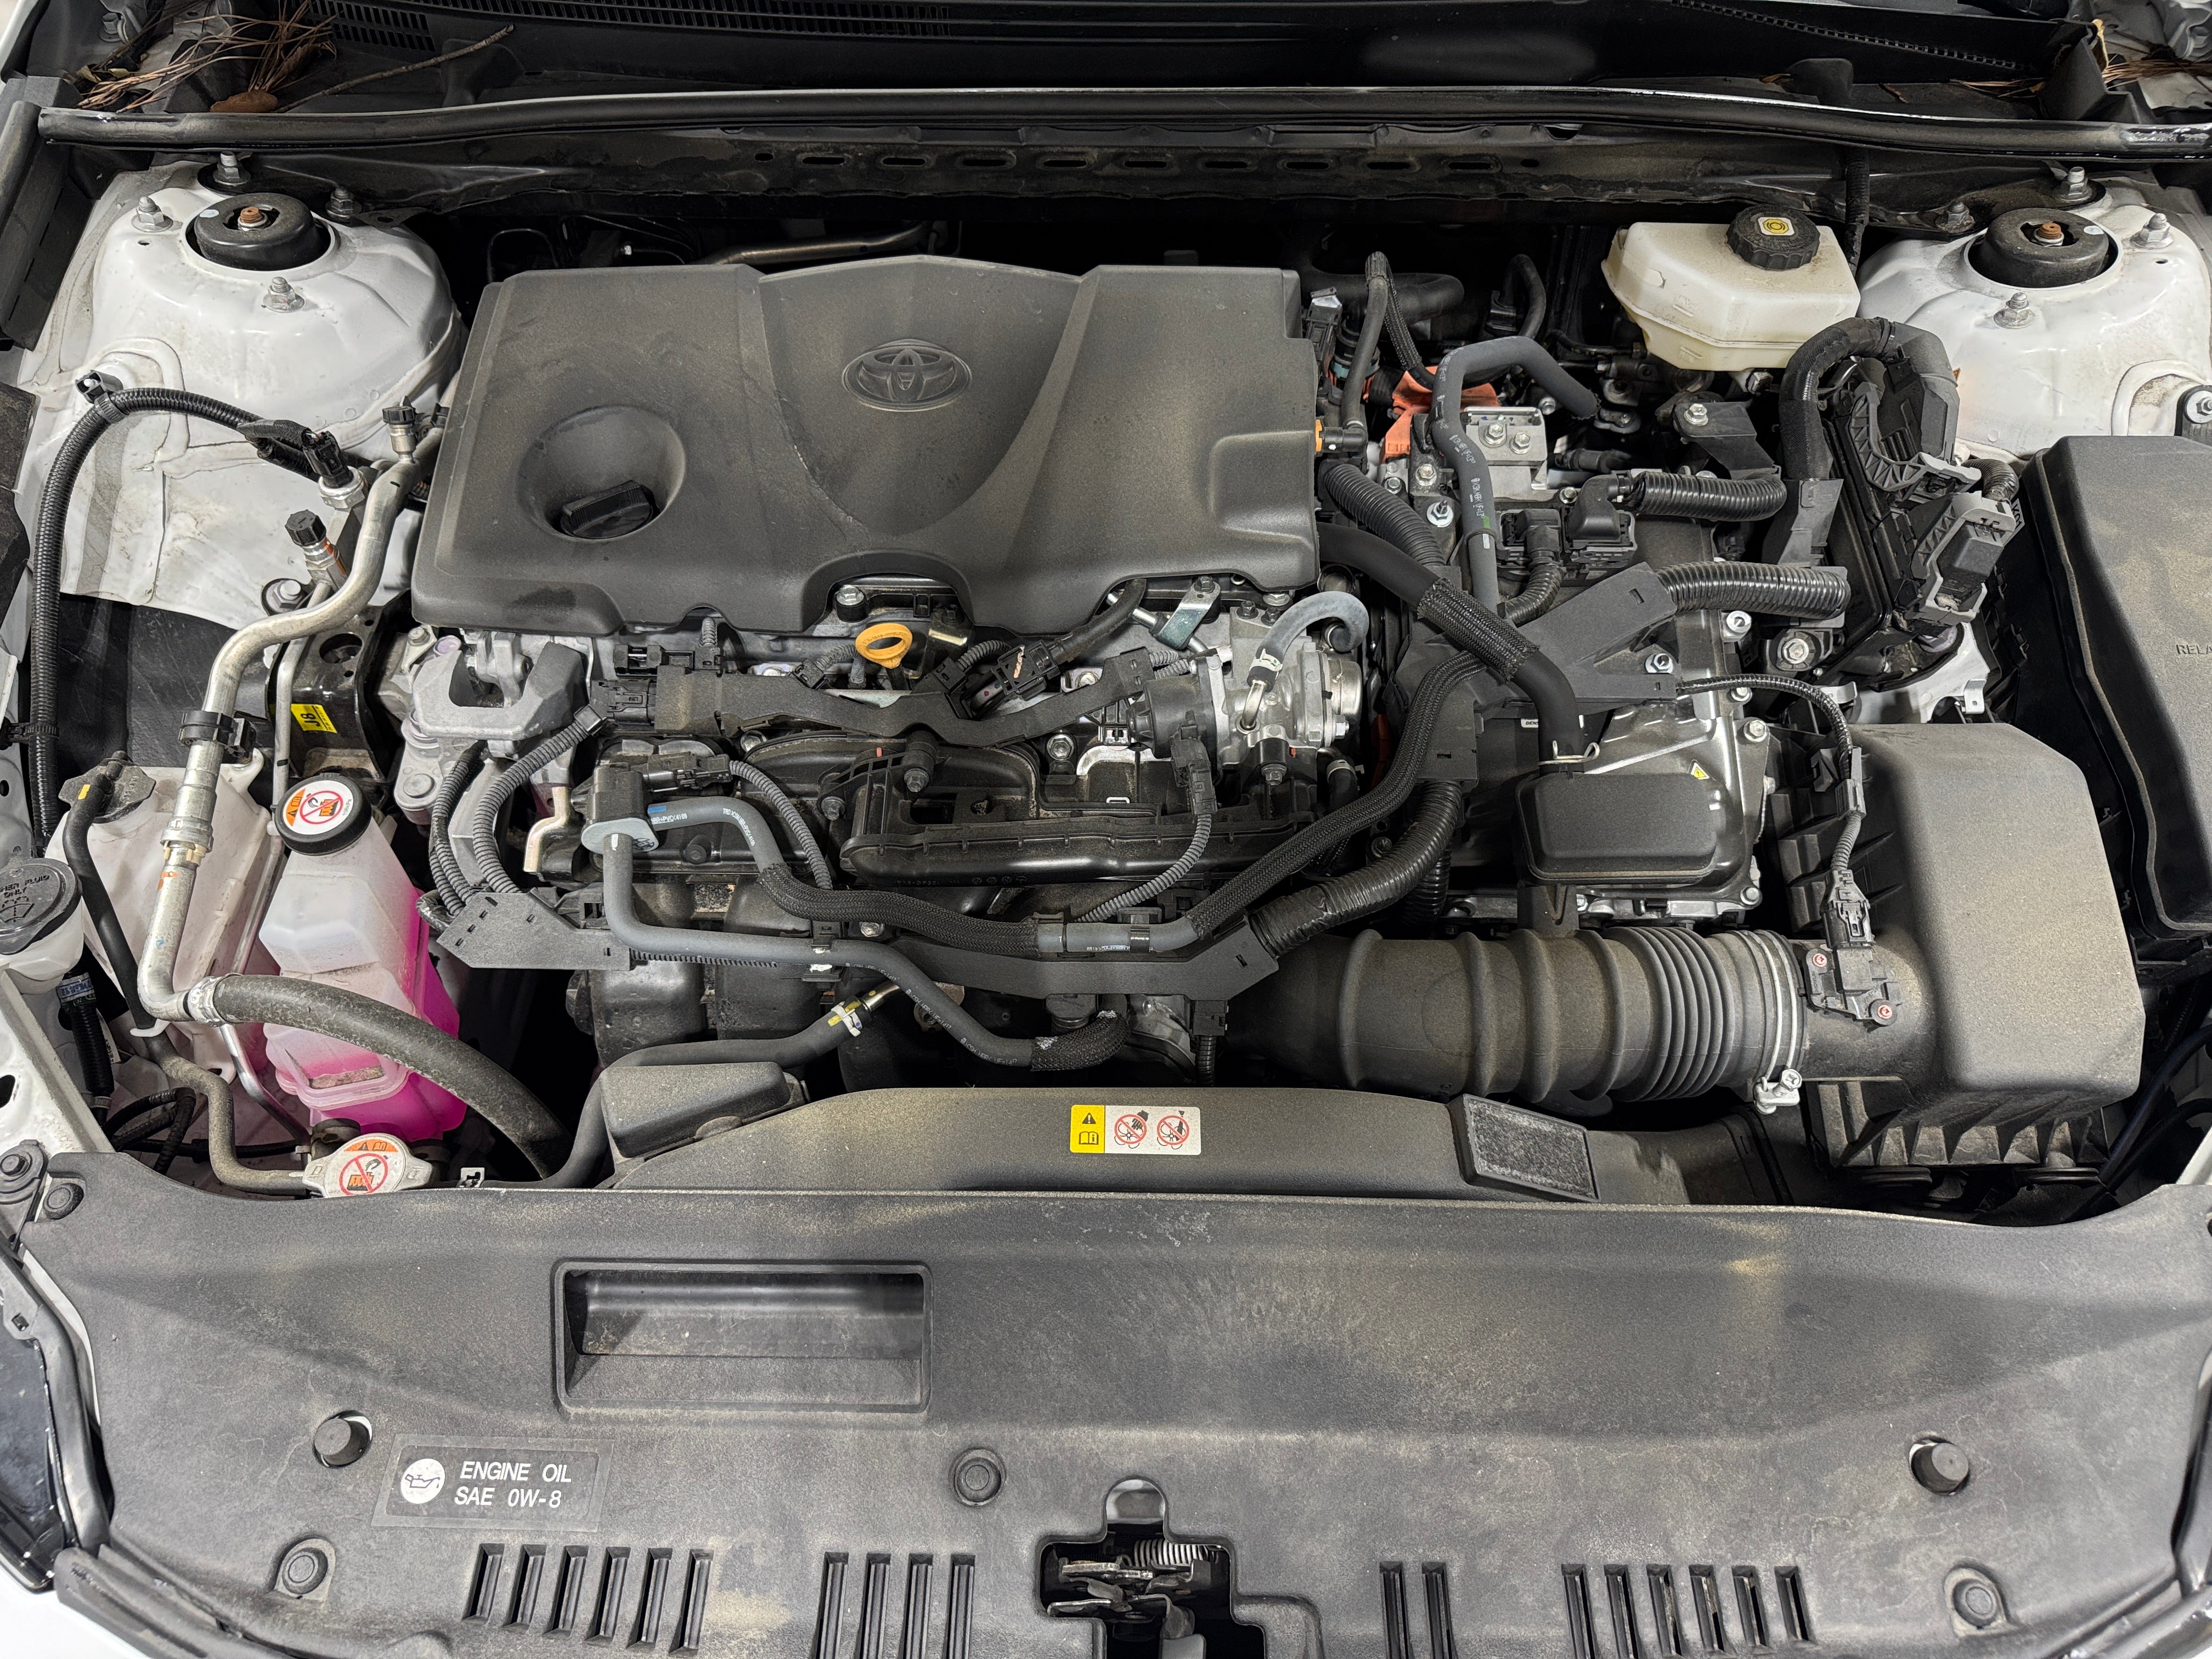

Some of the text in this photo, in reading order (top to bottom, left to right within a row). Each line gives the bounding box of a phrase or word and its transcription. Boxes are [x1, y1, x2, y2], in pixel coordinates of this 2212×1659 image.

[301, 713, 320, 727] J8
[25, 875, 50, 885] FLUID
[4, 887, 27, 898] ONLY
[460, 1460, 572, 1483] ENGINE OIL
[454, 1486, 562, 1508] SAE 0W-8
